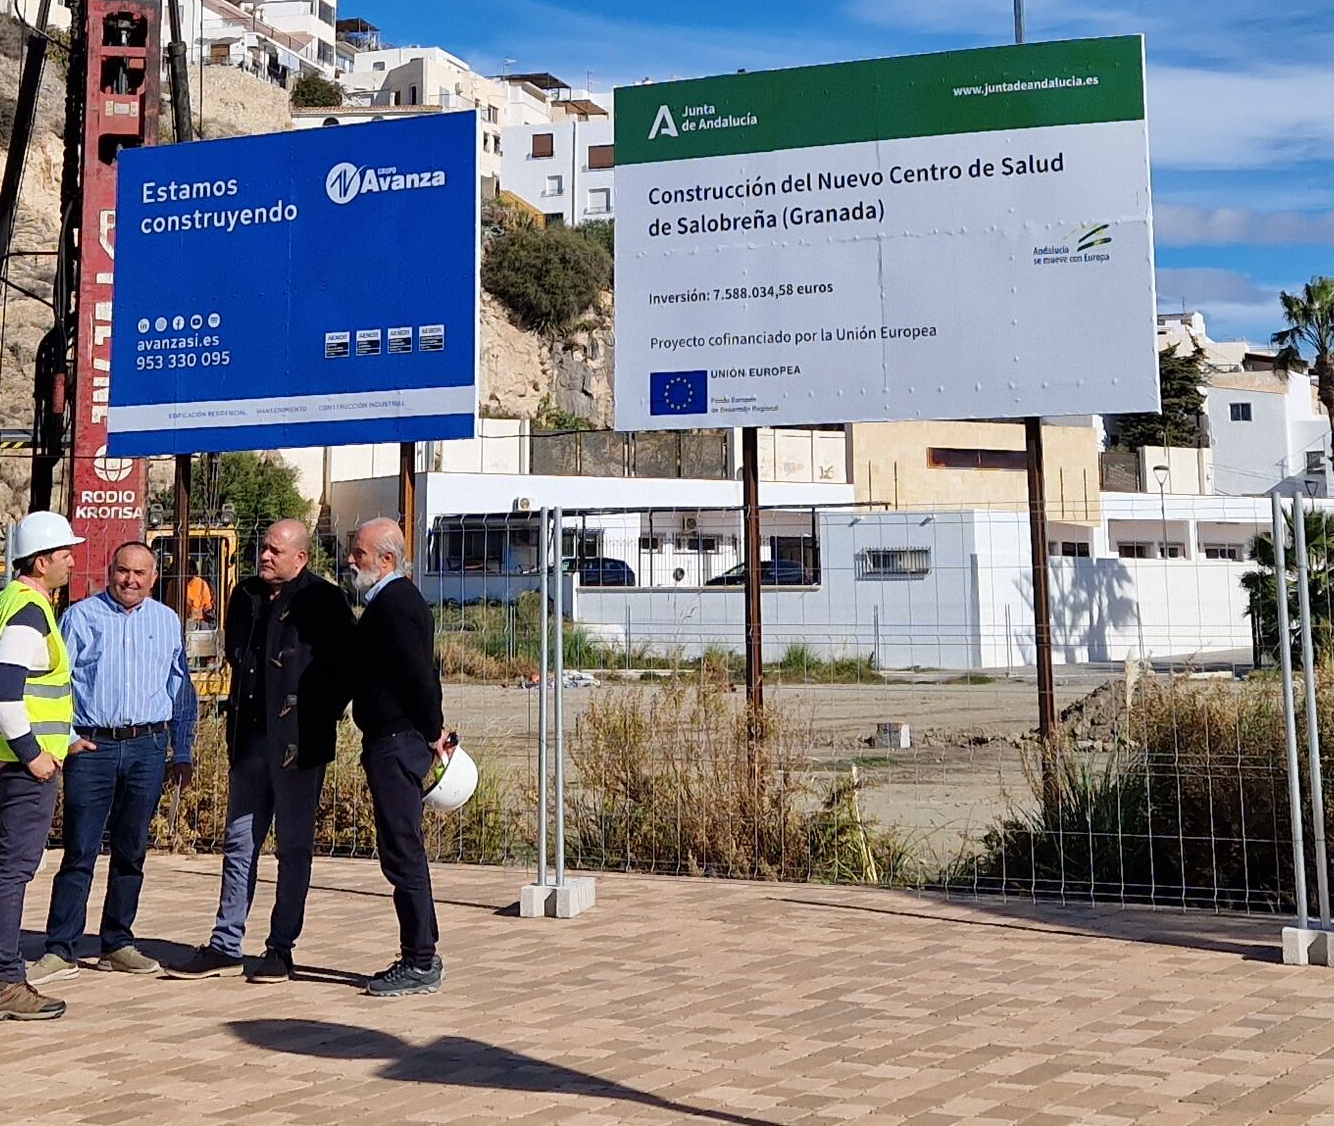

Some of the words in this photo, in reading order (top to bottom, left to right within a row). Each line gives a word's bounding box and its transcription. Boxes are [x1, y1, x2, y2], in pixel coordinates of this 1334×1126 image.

[953, 75, 1099, 96] www.juntadeandalucia.es
[682, 104, 715, 117] Junta
[682, 119, 696, 131] de
[699, 111, 758, 130] Andalucía
[360, 169, 446, 193] Avanza
[648, 175, 776, 205] Construcción
[781, 172, 812, 194] del
[818, 171, 884, 190] Nuevo
[890, 163, 962, 184] Centro
[968, 158, 995, 178] de
[1001, 152, 1064, 176] Salud
[142, 178, 238, 204] Estamos
[141, 199, 298, 234] construyendo
[648, 218, 672, 236] de
[677, 209, 778, 235] Salobreña
[783, 199, 885, 230] (Granada)
[649, 288, 710, 305] Inversión:
[713, 283, 794, 301] 7.588.034,58
[797, 282, 834, 295] euros
[137, 333, 220, 351] avanzasi.es
[650, 335, 705, 351] Proyecto
[708, 330, 792, 347] cofinanciado
[795, 331, 817, 345] por
[820, 328, 833, 342] la
[836, 325, 876, 341] Unión
[880, 325, 937, 341] Europea
[136, 355, 164, 371] 953
[168, 353, 197, 369] 330
[201, 351, 230, 366] 095
[749, 365, 801, 377] EUROPEA
[81, 490, 136, 504] RODIO
